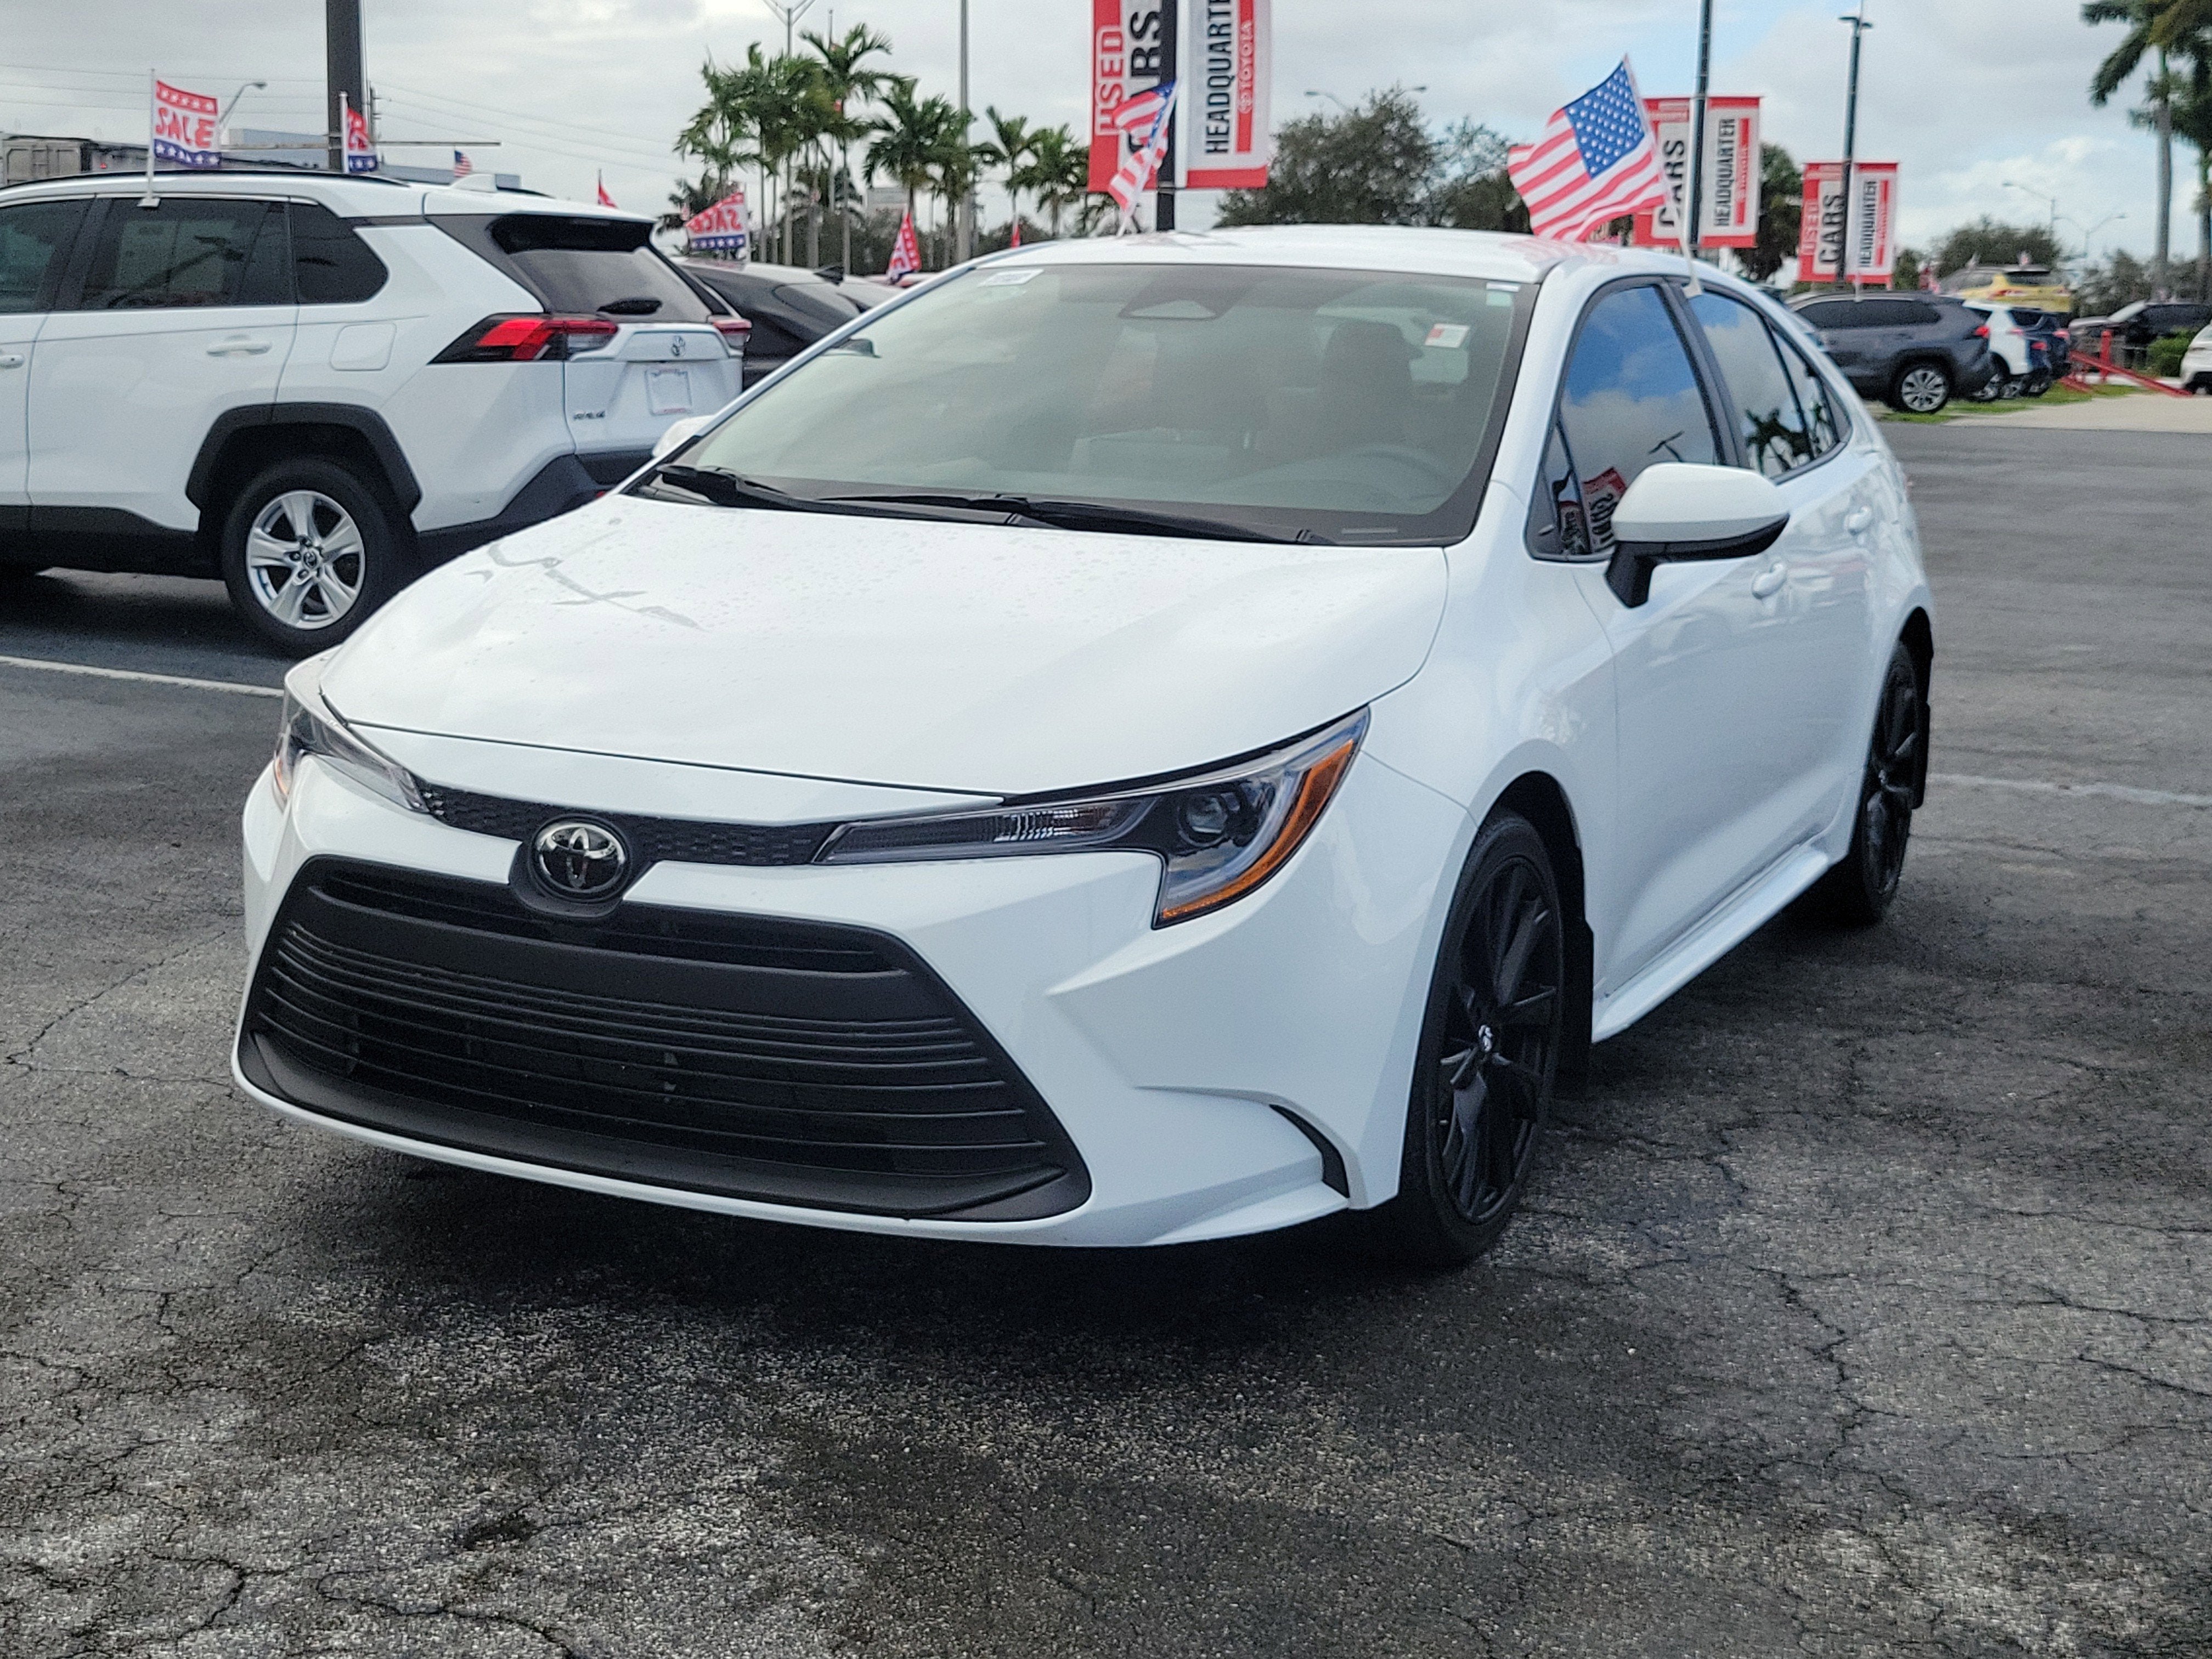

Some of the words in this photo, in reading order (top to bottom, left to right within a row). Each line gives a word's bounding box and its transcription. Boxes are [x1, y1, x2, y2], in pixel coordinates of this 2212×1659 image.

[1099, 31, 1123, 131] USED
[155, 107, 216, 149] SALE
[1714, 119, 1735, 226] HEADQUARTER
[1802, 201, 1819, 253] USED
[1819, 195, 1846, 263] CARS
